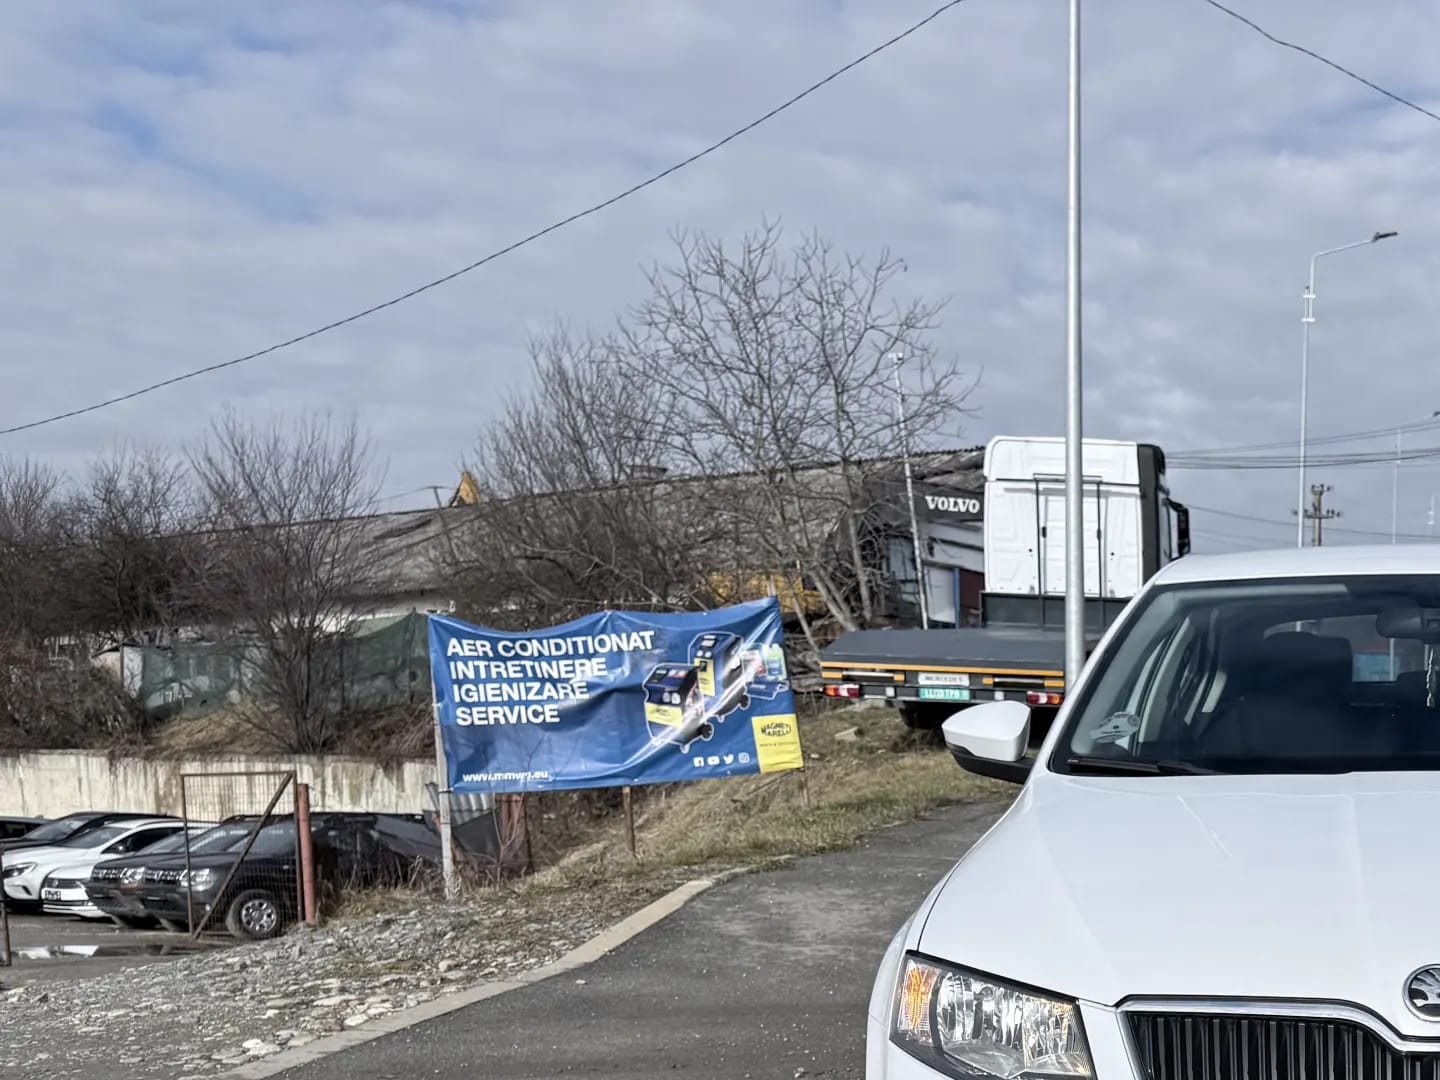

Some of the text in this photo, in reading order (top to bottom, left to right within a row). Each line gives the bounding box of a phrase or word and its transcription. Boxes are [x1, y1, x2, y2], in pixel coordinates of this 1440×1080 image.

[925, 495, 981, 514] VOLVO
[447, 631, 656, 657] AER CONDITIONAT
[449, 657, 609, 680] INTRETINERE
[453, 681, 591, 703] IGIENIZARE
[455, 704, 561, 726] SERVICE
